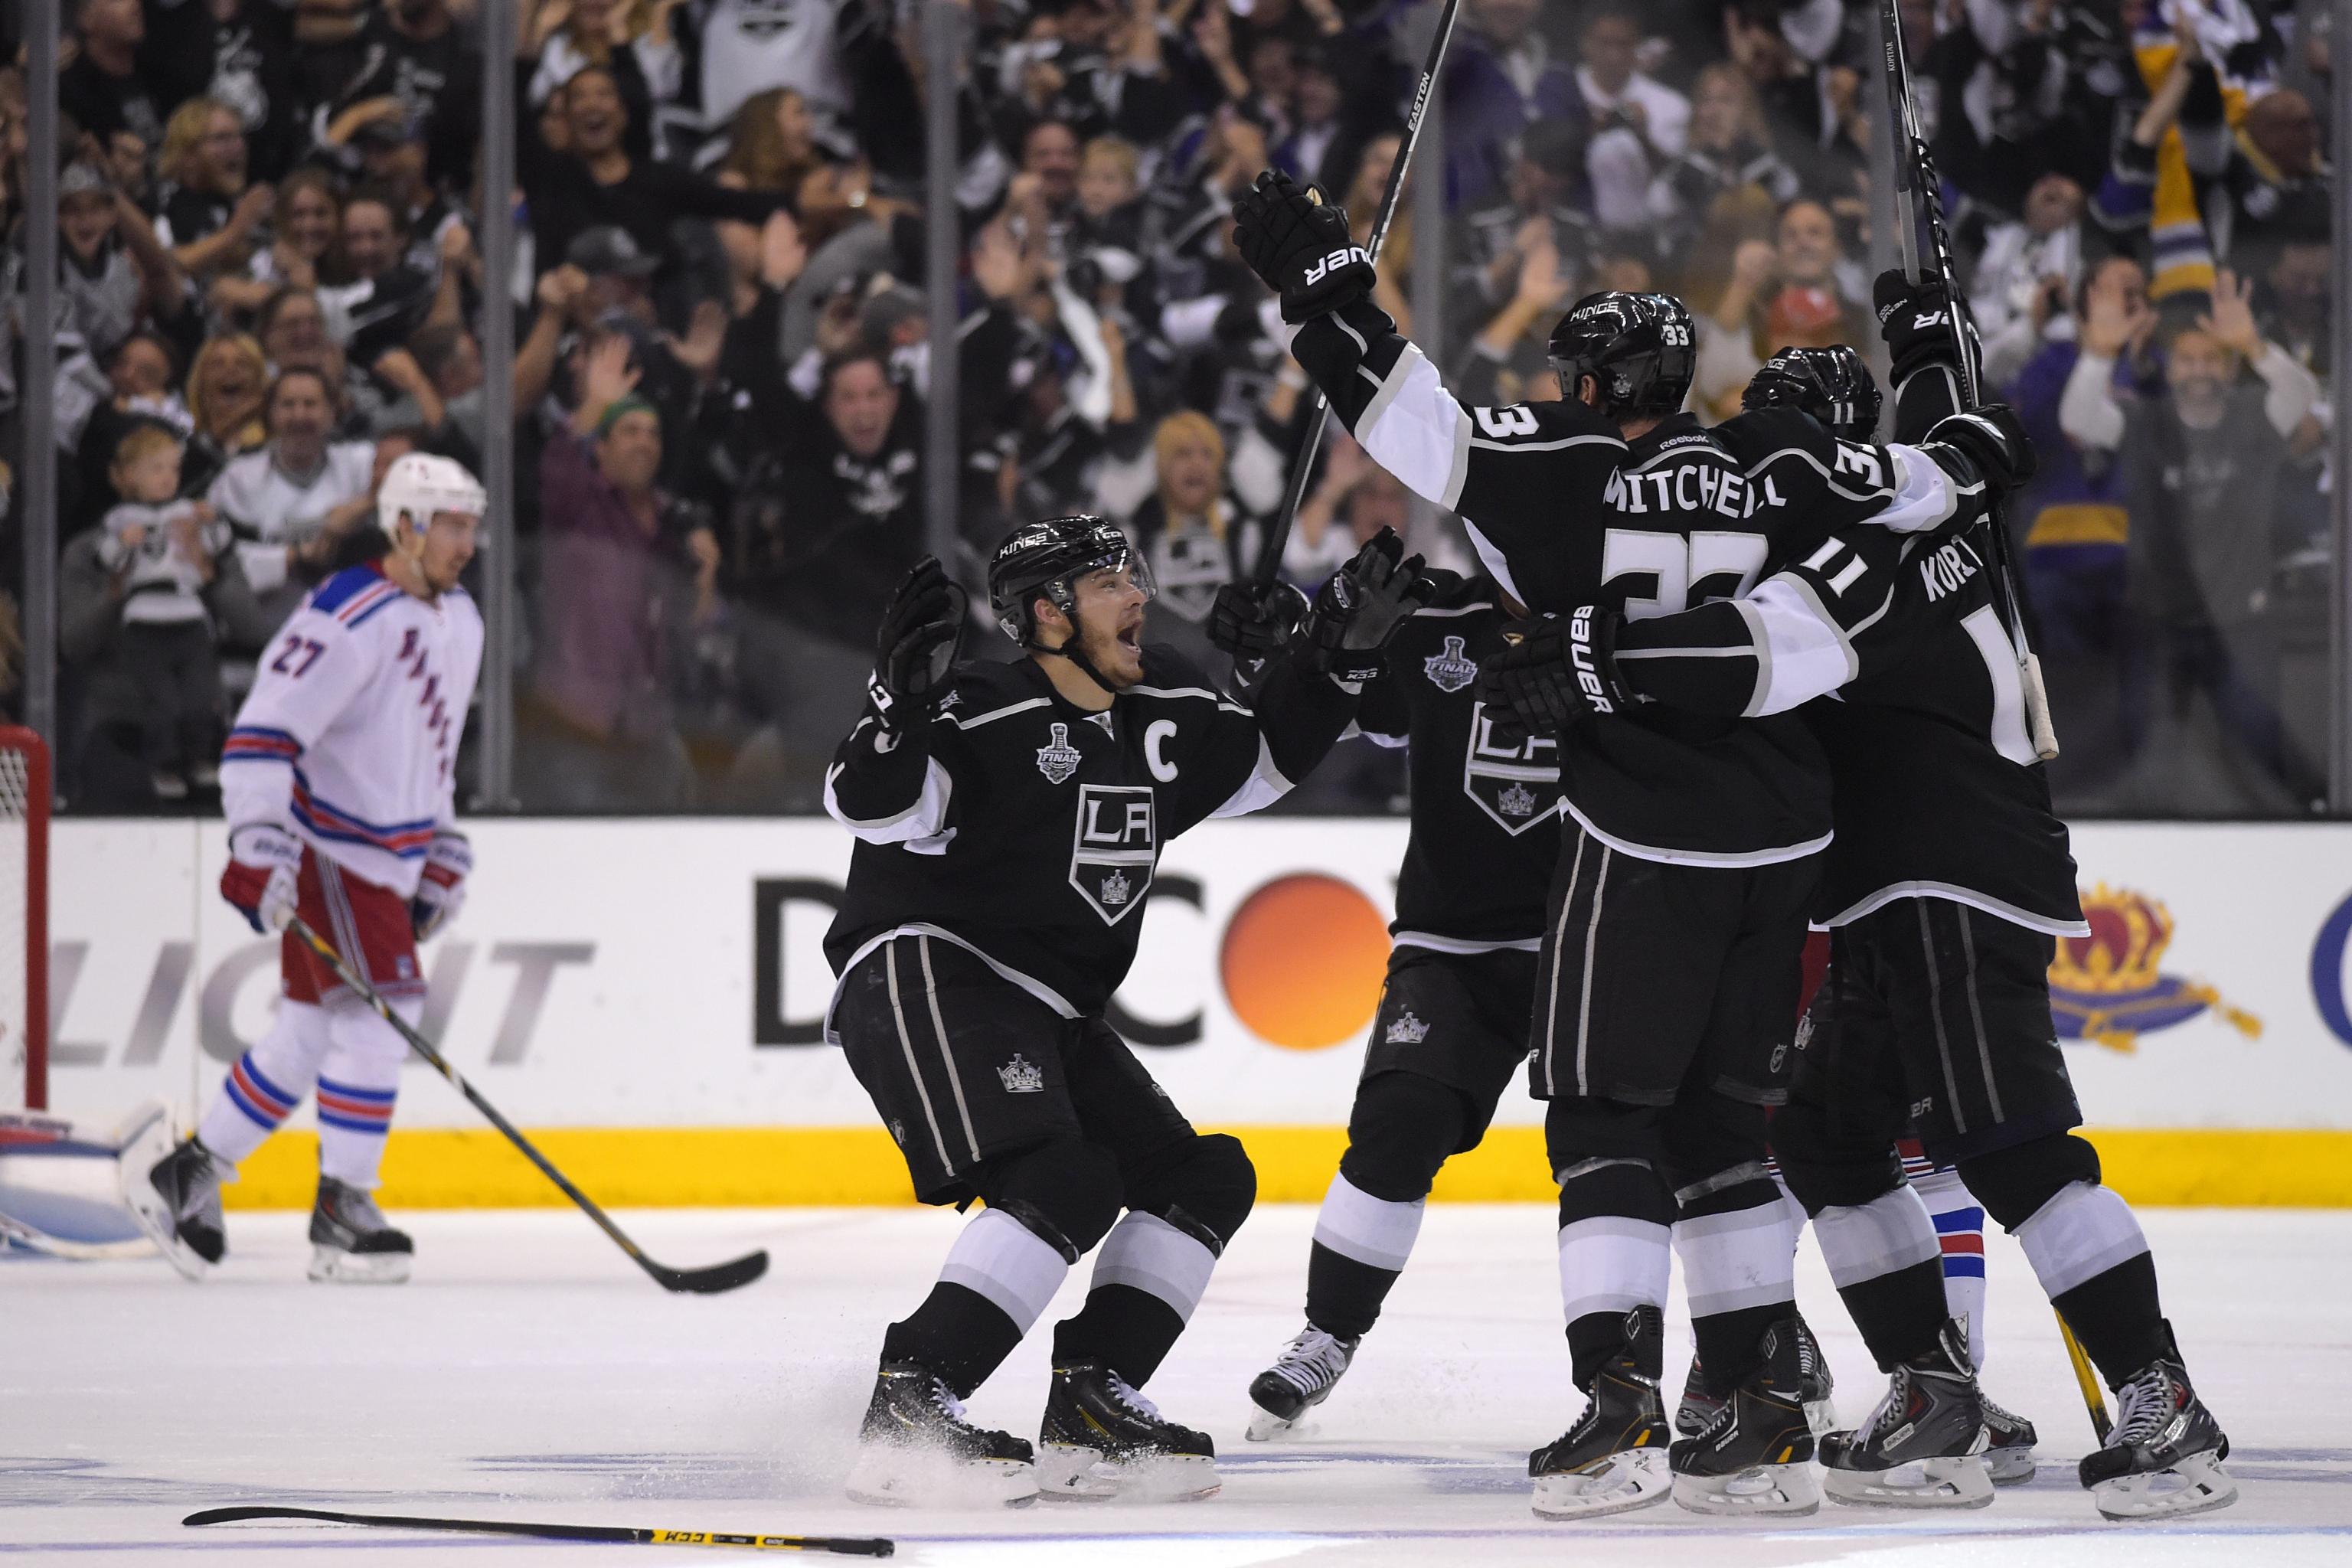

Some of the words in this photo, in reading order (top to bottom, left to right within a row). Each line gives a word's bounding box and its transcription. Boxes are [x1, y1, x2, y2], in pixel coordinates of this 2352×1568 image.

[1886, 41, 1895, 72] KOPITAR
[1408, 71, 1430, 132] EASTON
[1570, 301, 1620, 322] KINGS
[1661, 324, 1690, 346] 33
[1832, 402, 1854, 424] 11
[1659, 433, 1709, 450] Reebok
[999, 531, 1048, 559] KINGS
[1798, 536, 1868, 598] 11
[269, 633, 326, 680] 27
[1430, 662, 1474, 674] FINAL
[1570, 604, 1615, 714] BAUER
[1041, 753, 1076, 763] FINAL
[1144, 718, 1179, 783] C
[1083, 799, 1152, 843] LA
[665, 1530, 705, 1543] CCM
